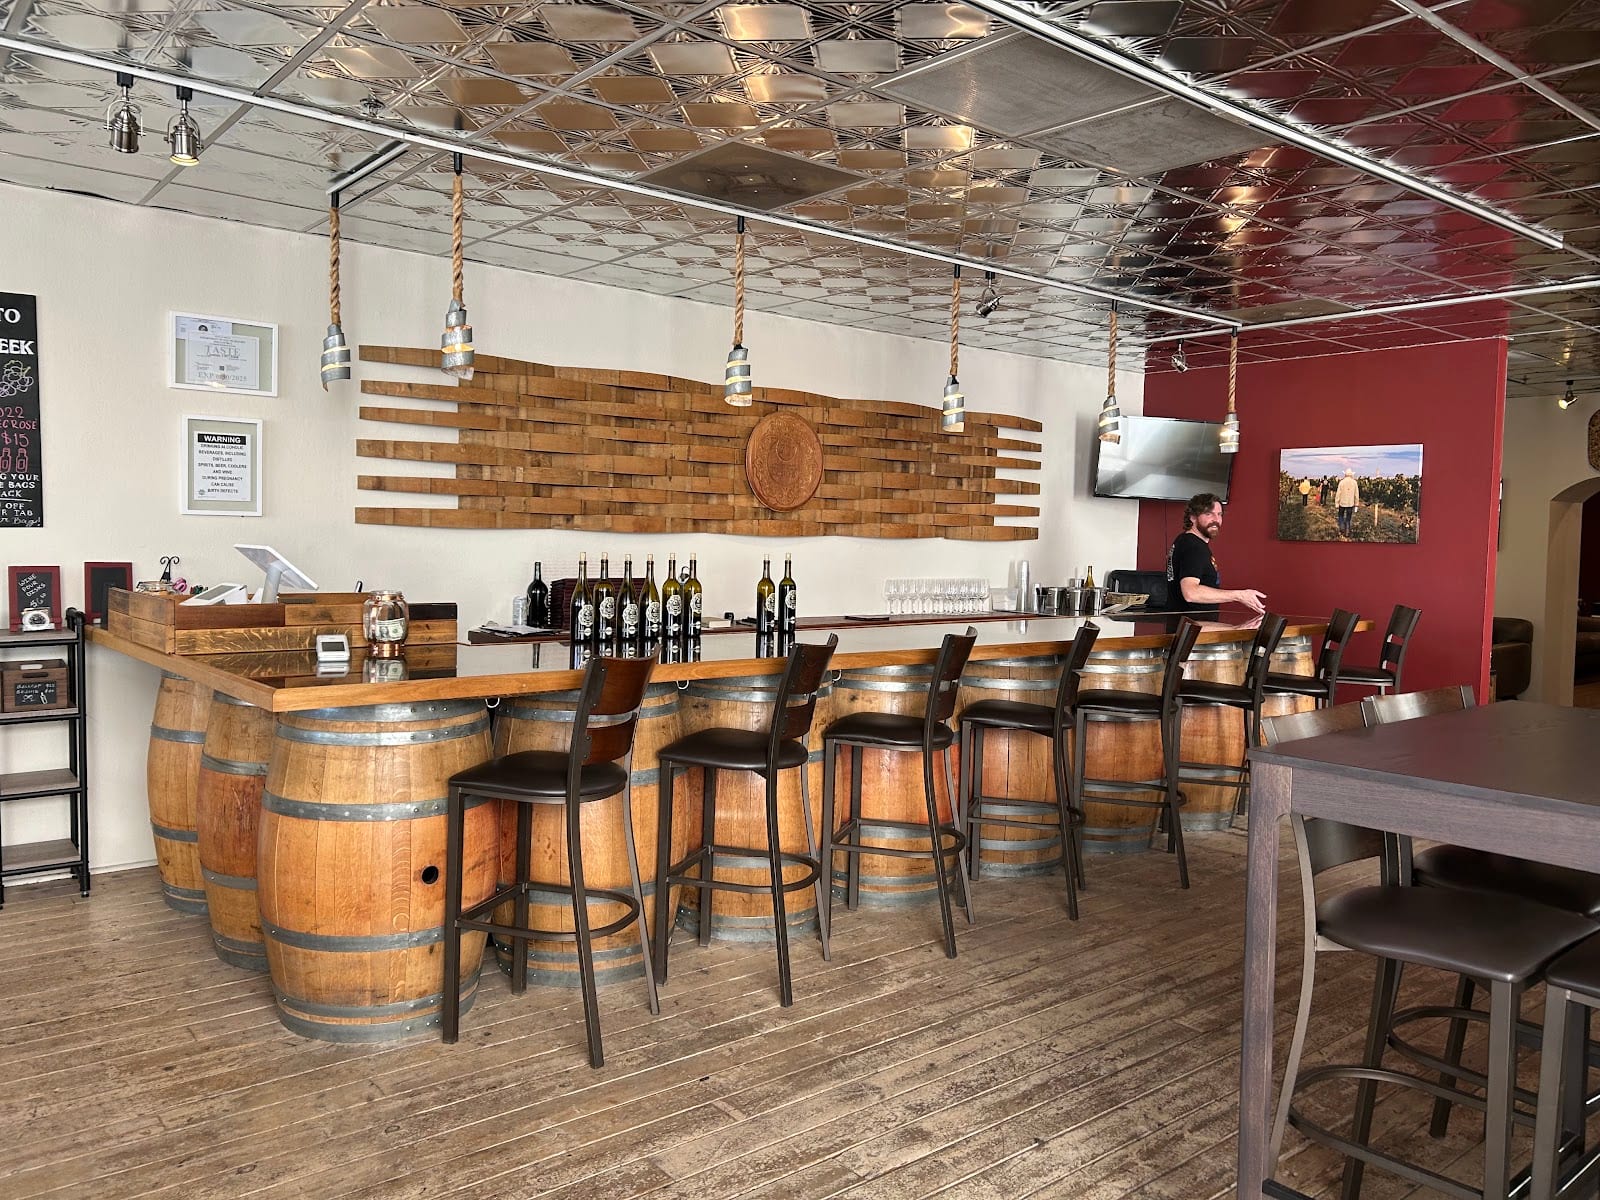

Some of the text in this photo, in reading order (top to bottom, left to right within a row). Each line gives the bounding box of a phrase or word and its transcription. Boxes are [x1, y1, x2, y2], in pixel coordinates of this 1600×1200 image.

[0, 339, 35, 355] EEK
[203, 435, 241, 444] WARNING
[11, 473, 40, 481] YOUR
[8, 481, 36, 489] BAGS
[0, 489, 22, 497] ACK
[5, 502, 25, 510] OFF
[13, 509, 33, 517] TAB
[18, 573, 37, 587] WINE
[21, 580, 39, 592] POUR
